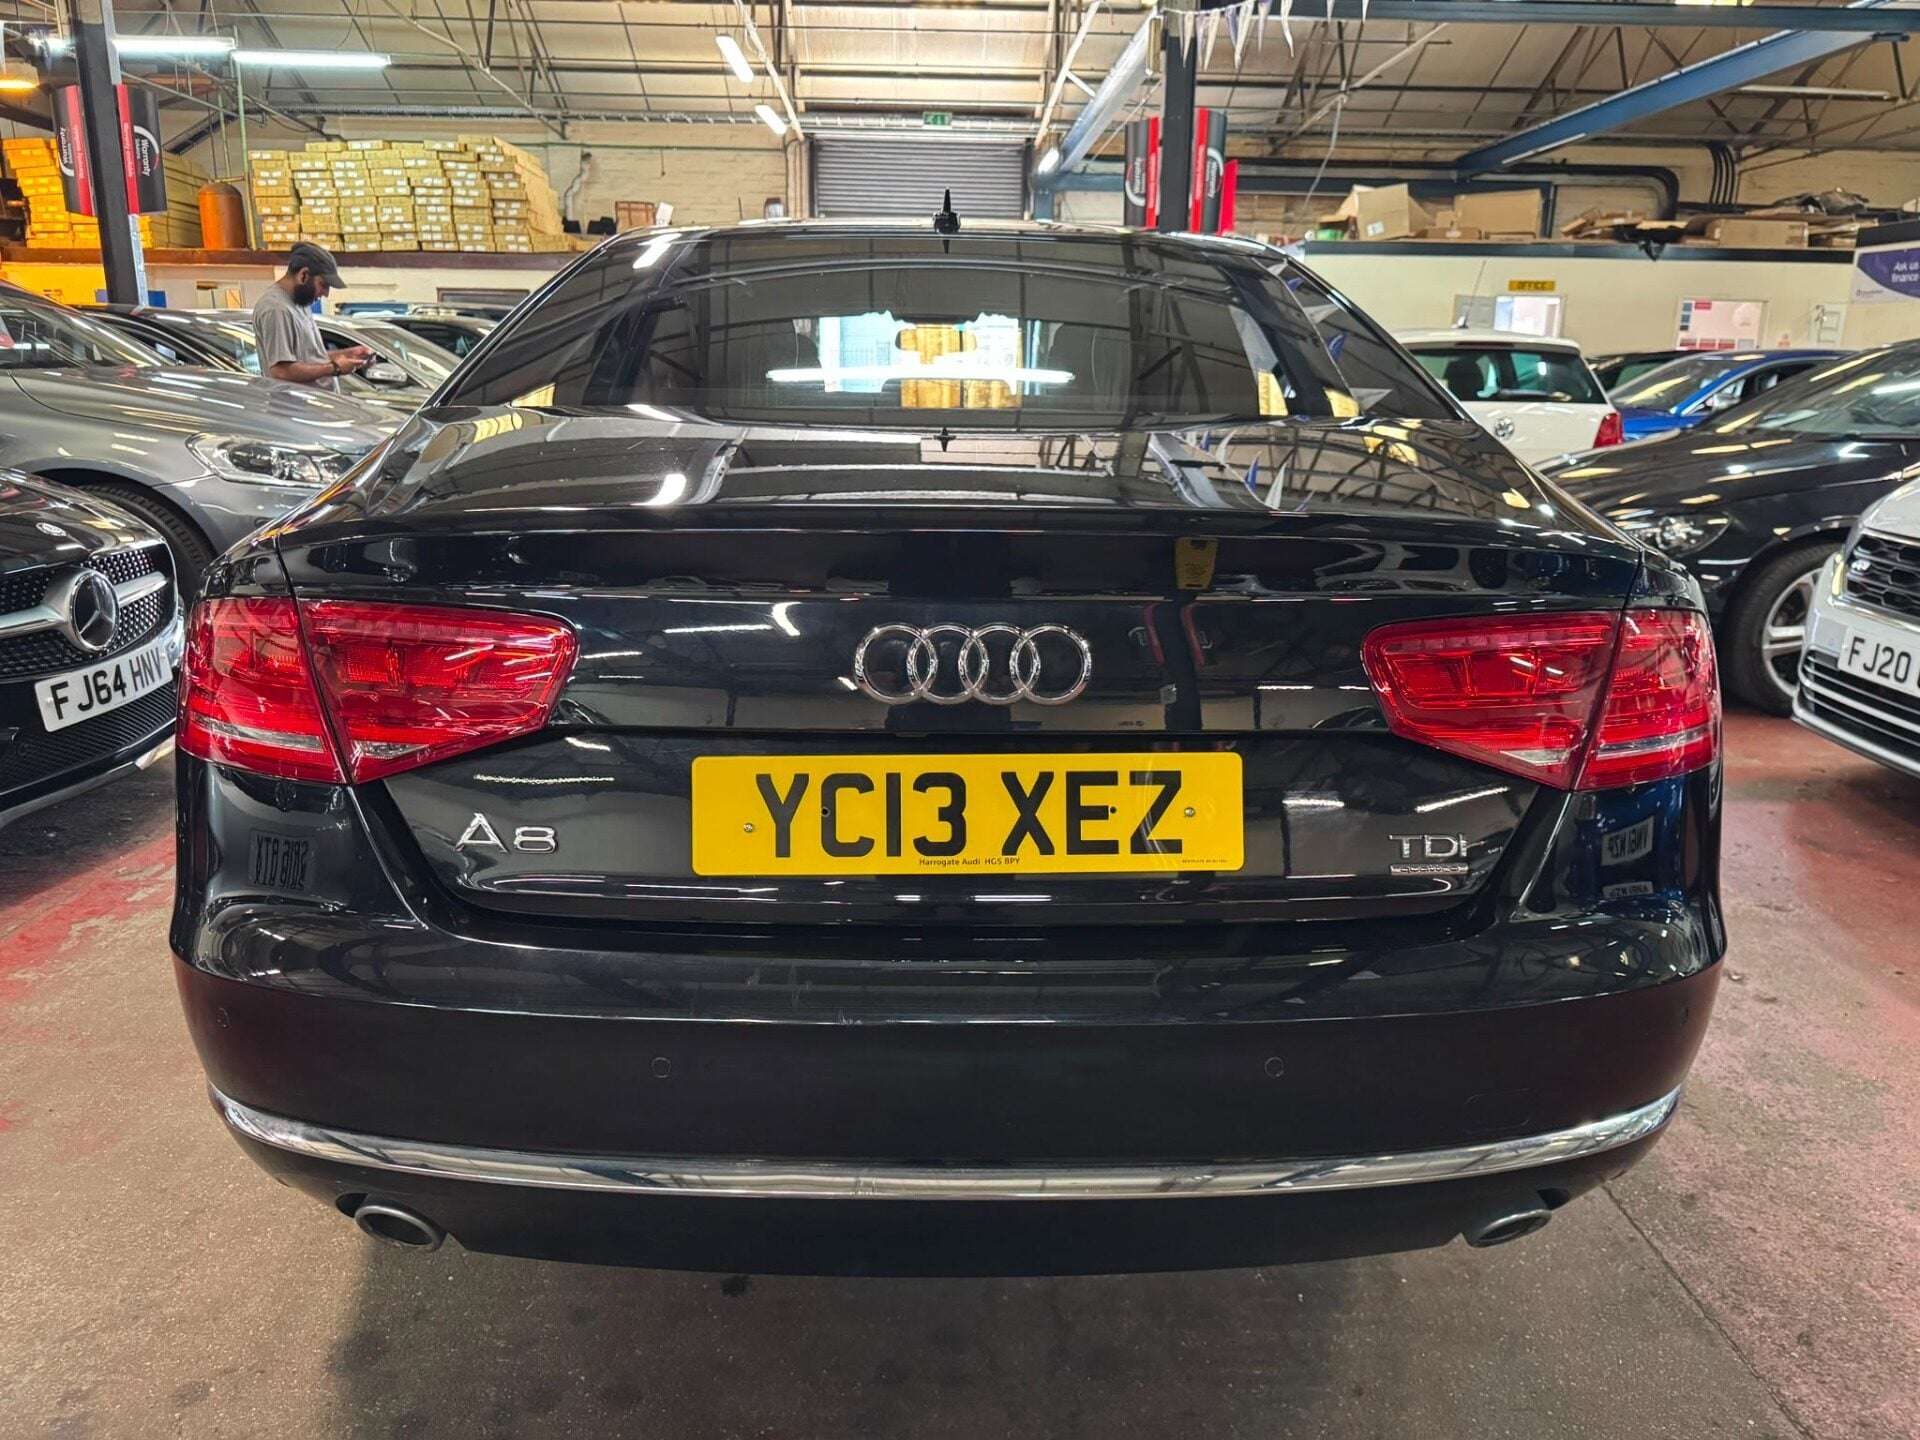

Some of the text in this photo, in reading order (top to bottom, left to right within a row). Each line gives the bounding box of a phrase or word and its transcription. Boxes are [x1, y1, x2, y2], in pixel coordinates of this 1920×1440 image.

[141, 139, 151, 176] Warranty
[1848, 635, 1911, 684] FJ20
[50, 647, 162, 720] FJ64 HNV
[455, 812, 556, 853] A8
[756, 770, 1183, 858] YC13 XEZ
[919, 859, 960, 868] Harrogate
[962, 858, 981, 866] Audi
